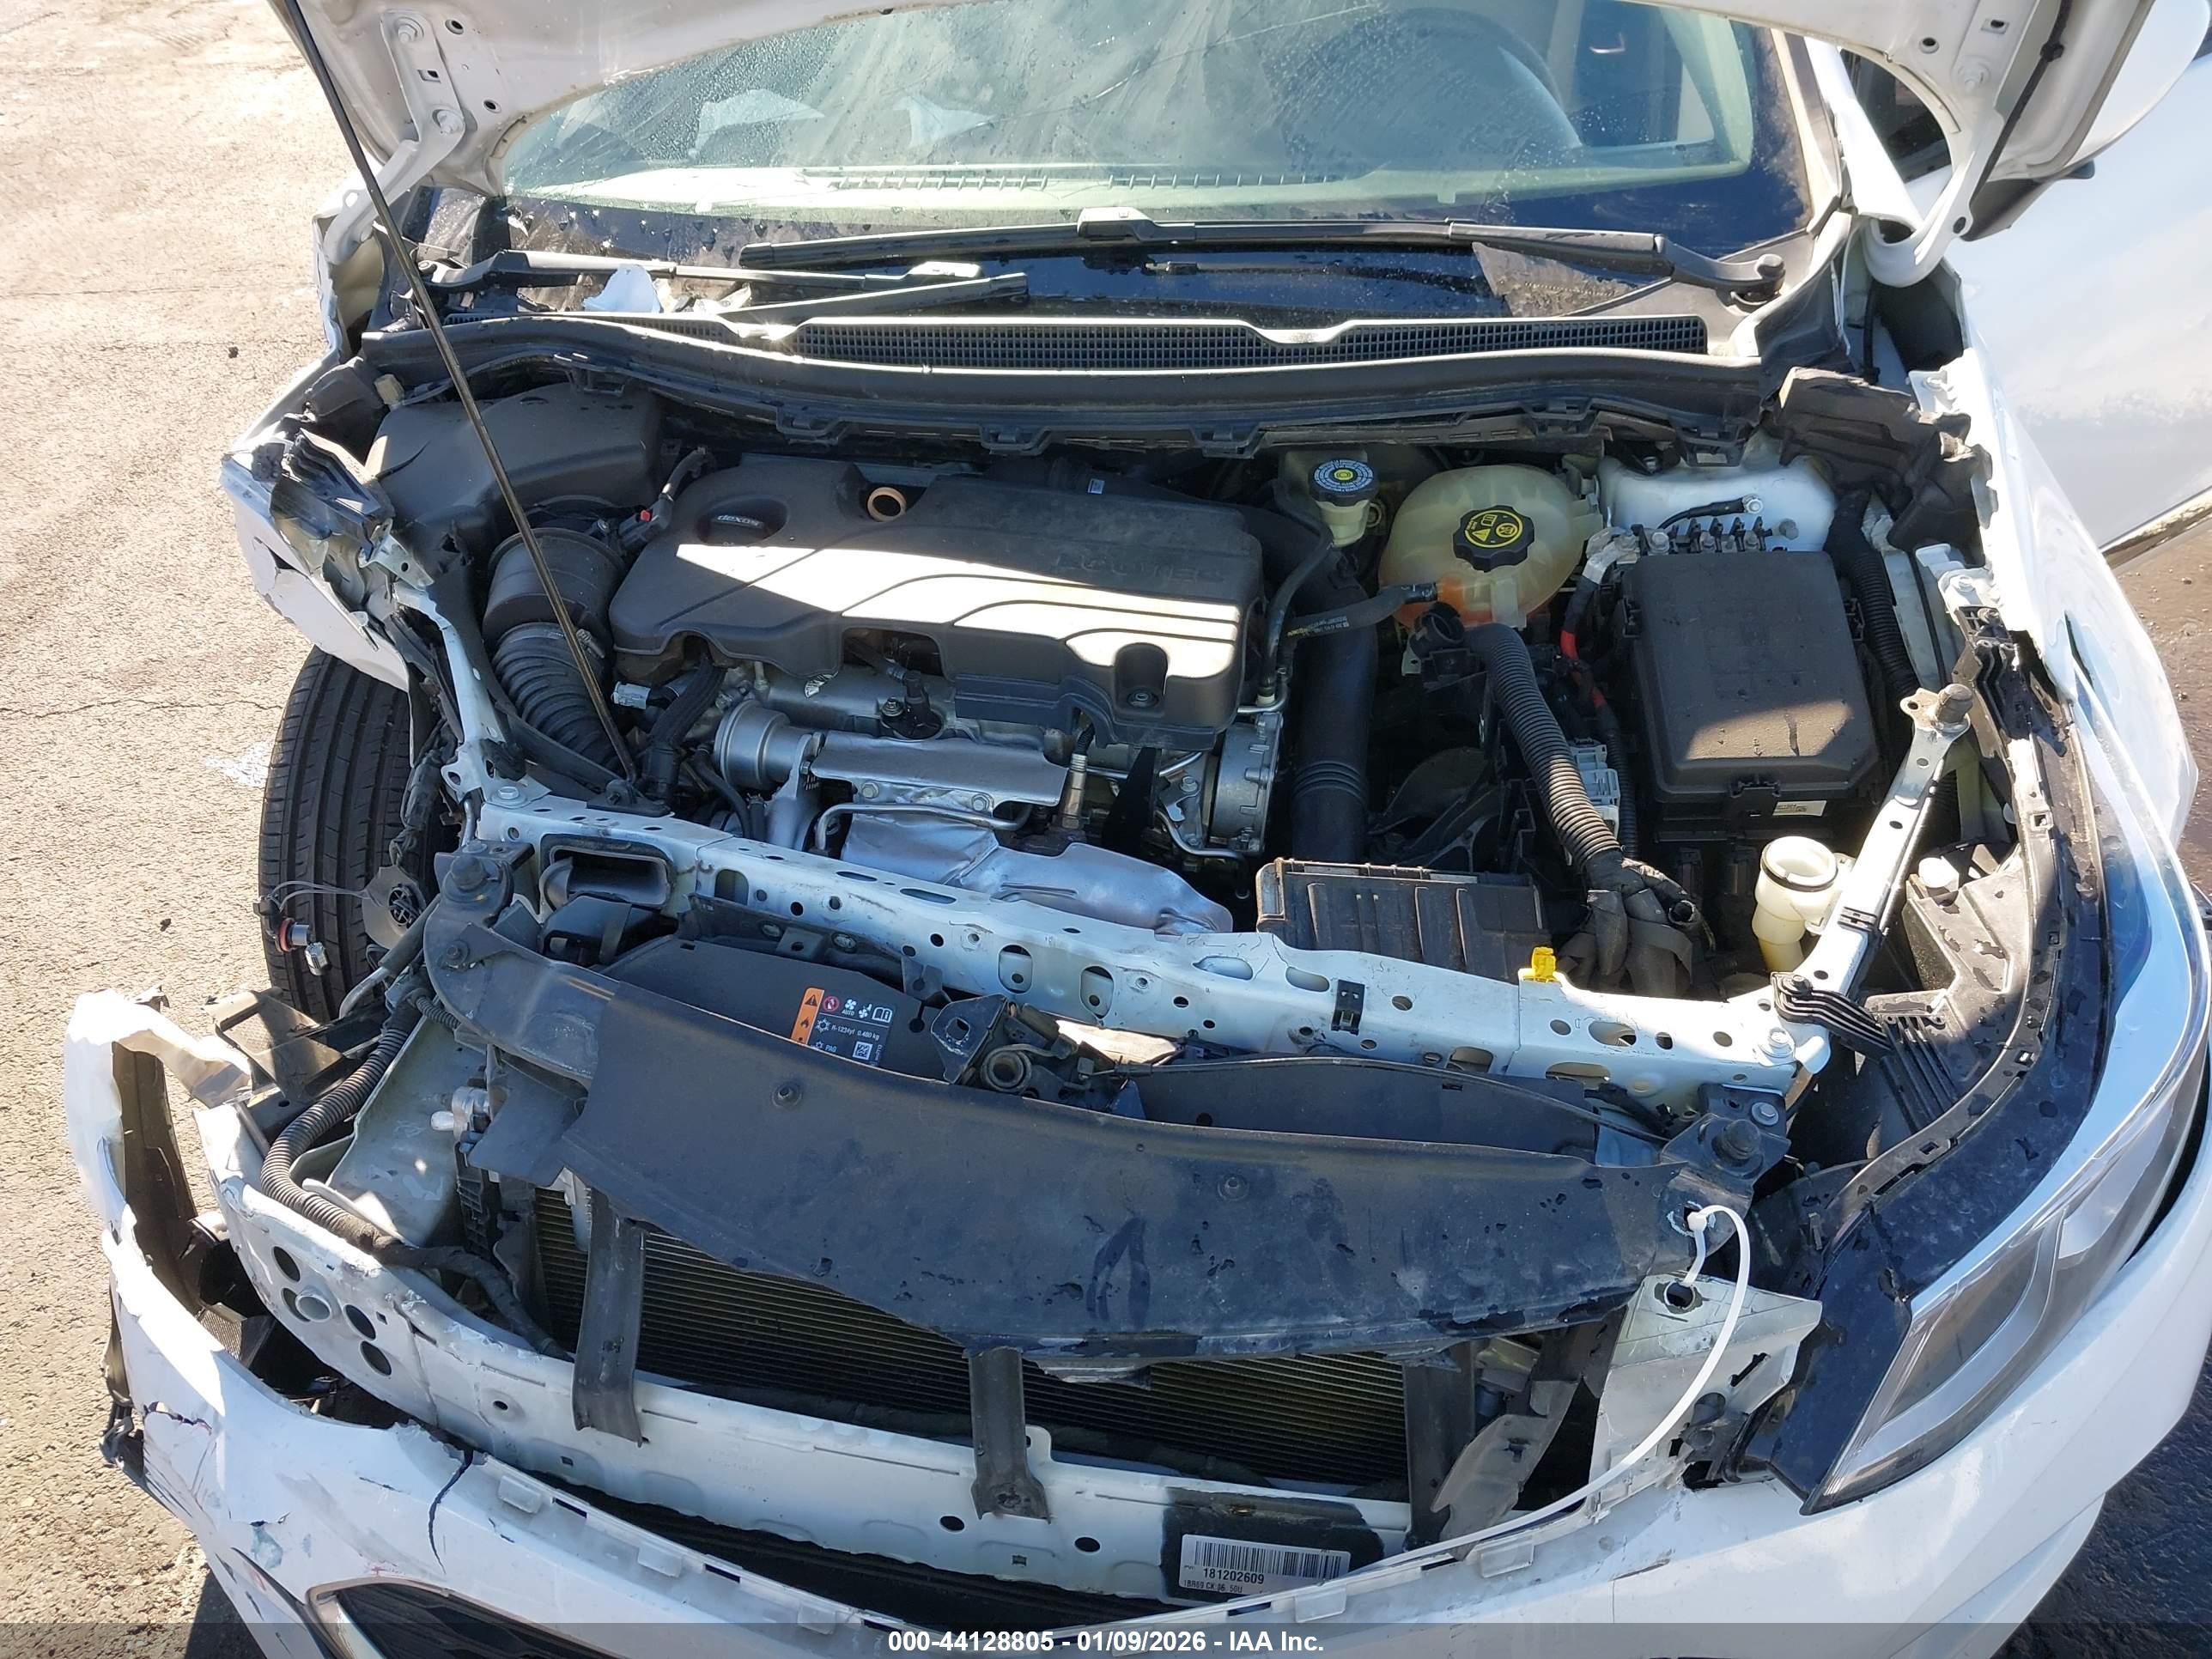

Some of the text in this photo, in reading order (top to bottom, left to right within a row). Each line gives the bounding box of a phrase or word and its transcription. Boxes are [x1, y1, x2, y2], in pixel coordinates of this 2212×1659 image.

[717, 514, 760, 526] dexos
[872, 1031, 880, 1041] kg
[1203, 1567, 1265, 1584] 181202609
